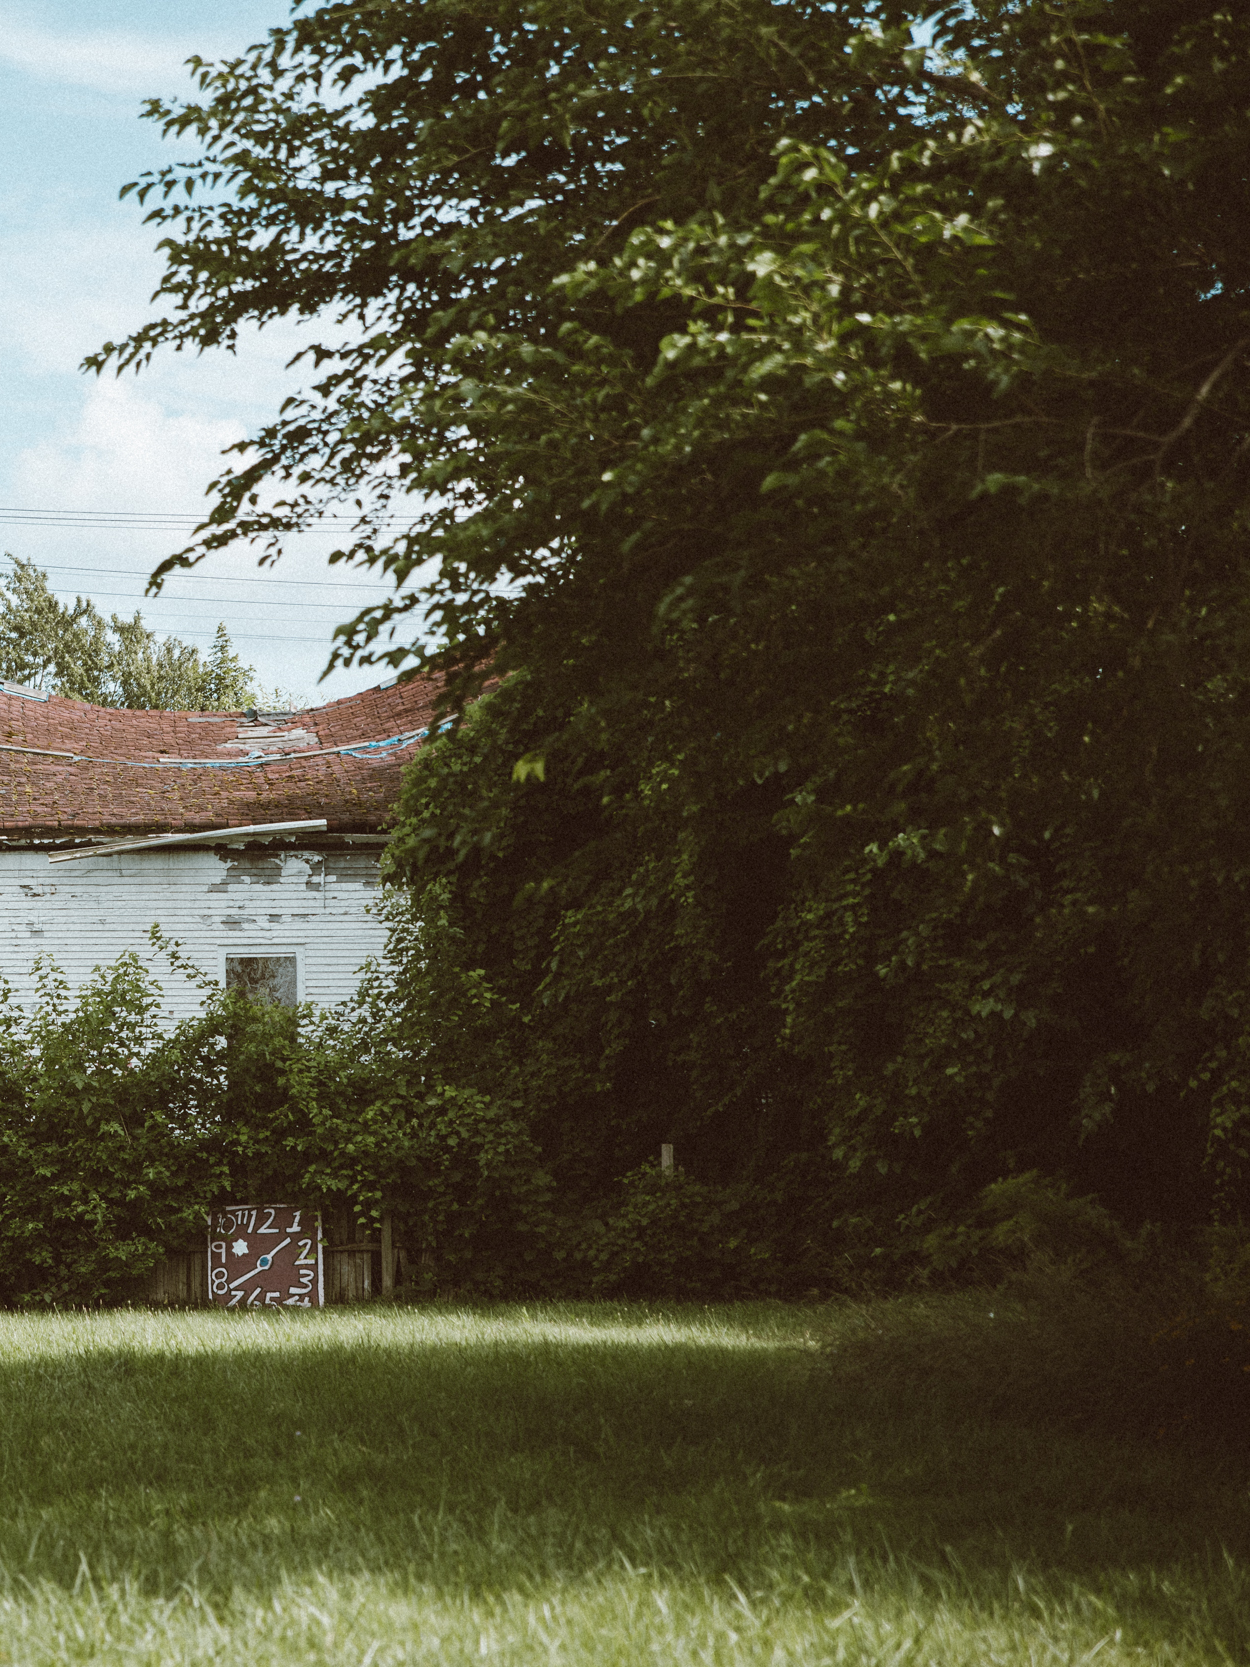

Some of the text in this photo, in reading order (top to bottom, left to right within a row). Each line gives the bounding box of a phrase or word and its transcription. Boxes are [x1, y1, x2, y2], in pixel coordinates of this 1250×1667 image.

[247, 1208, 279, 1234] 12
[286, 1210, 301, 1233] 1
[211, 1241, 226, 1263] 9
[294, 1239, 315, 1265] 2
[212, 1267, 228, 1295] 8
[289, 1269, 314, 1294] 3
[227, 1291, 245, 1308] 7
[247, 1287, 262, 1309] 6
